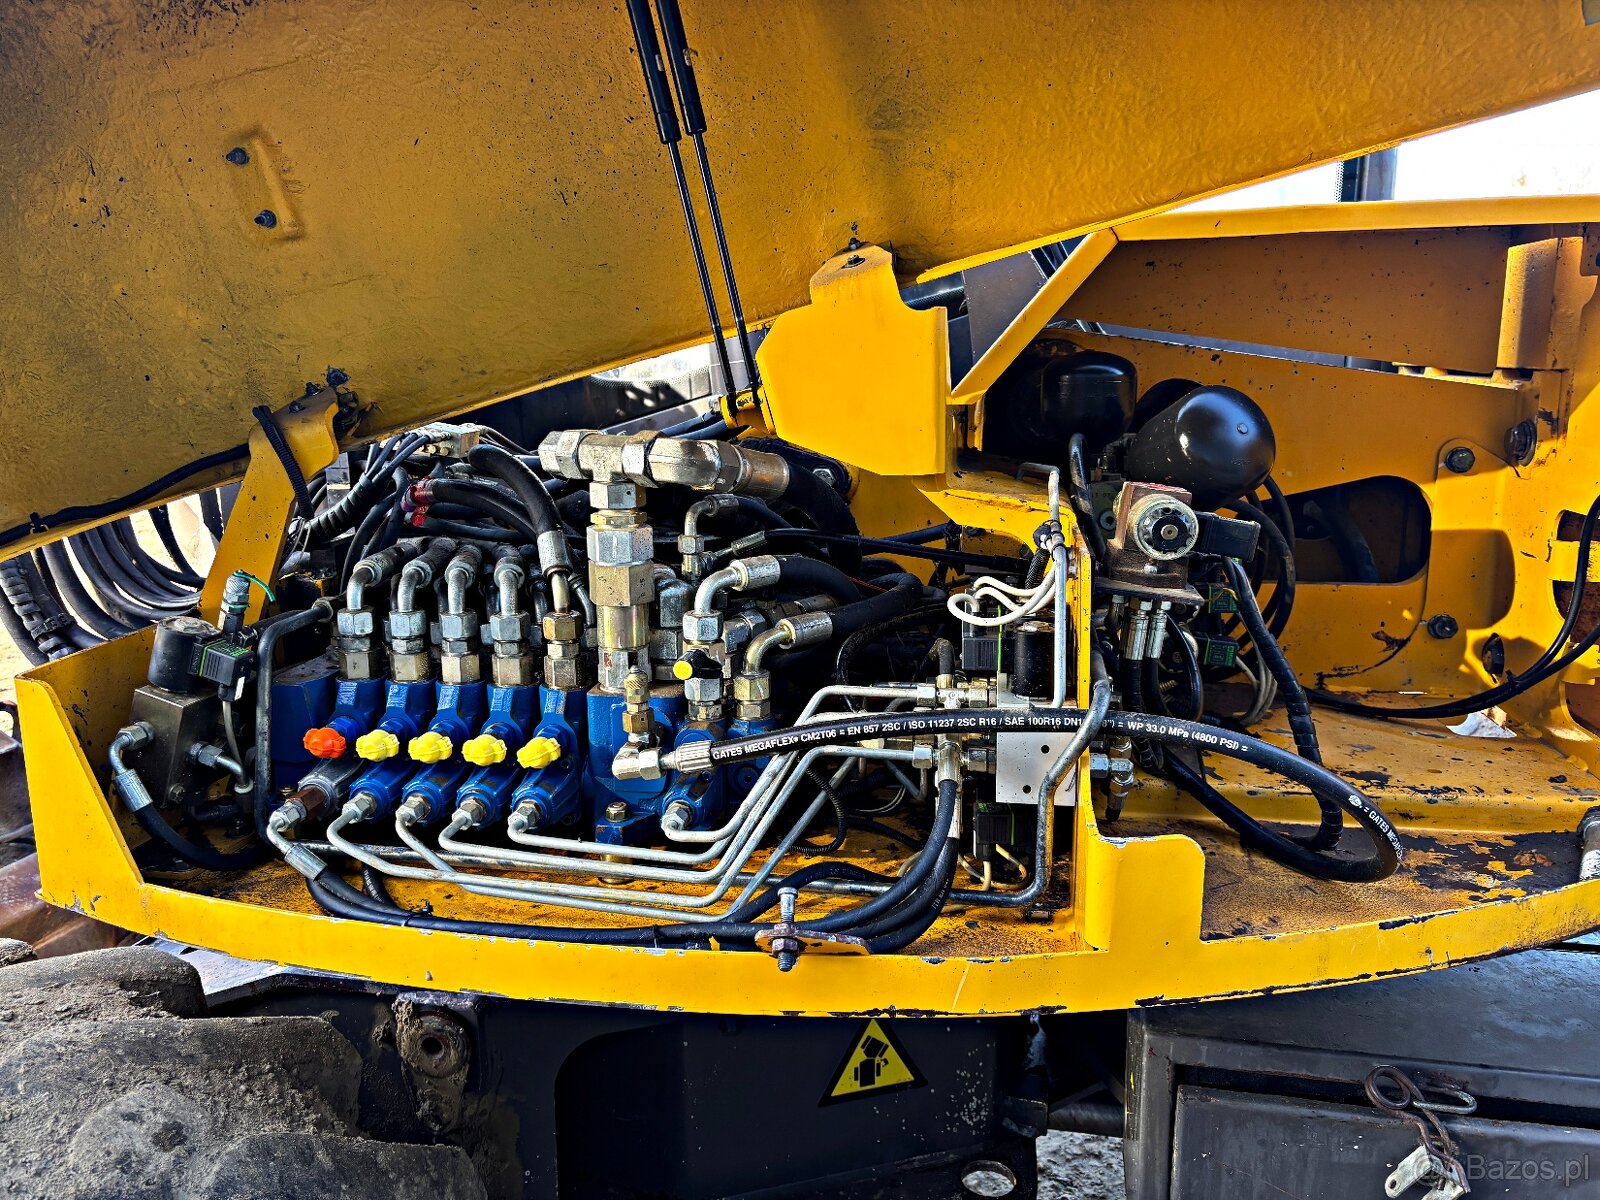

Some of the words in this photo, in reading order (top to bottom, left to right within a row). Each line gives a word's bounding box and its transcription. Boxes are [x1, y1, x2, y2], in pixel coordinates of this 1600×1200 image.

[712, 747, 743, 760] GATES
[800, 728, 837, 743] CM2T06
[847, 724, 861, 736] EN
[863, 723, 880, 734] 857
[882, 722, 901, 732] 2SC
[908, 720, 926, 730] ISO
[927, 718, 955, 729] 11237
[957, 717, 977, 727] 2SC
[979, 717, 997, 726] R16
[1004, 716, 1025, 726] SAE
[1027, 716, 1062, 726] 100R16
[1063, 717, 1083, 726] DN1
[1127, 721, 1144, 731] WP
[1146, 723, 1167, 734] 33.0
[1168, 726, 1189, 738] MPa
[1191, 731, 1218, 745] (4800
[1219, 737, 1239, 751] PSI)
[1368, 810, 1390, 833] GATES
